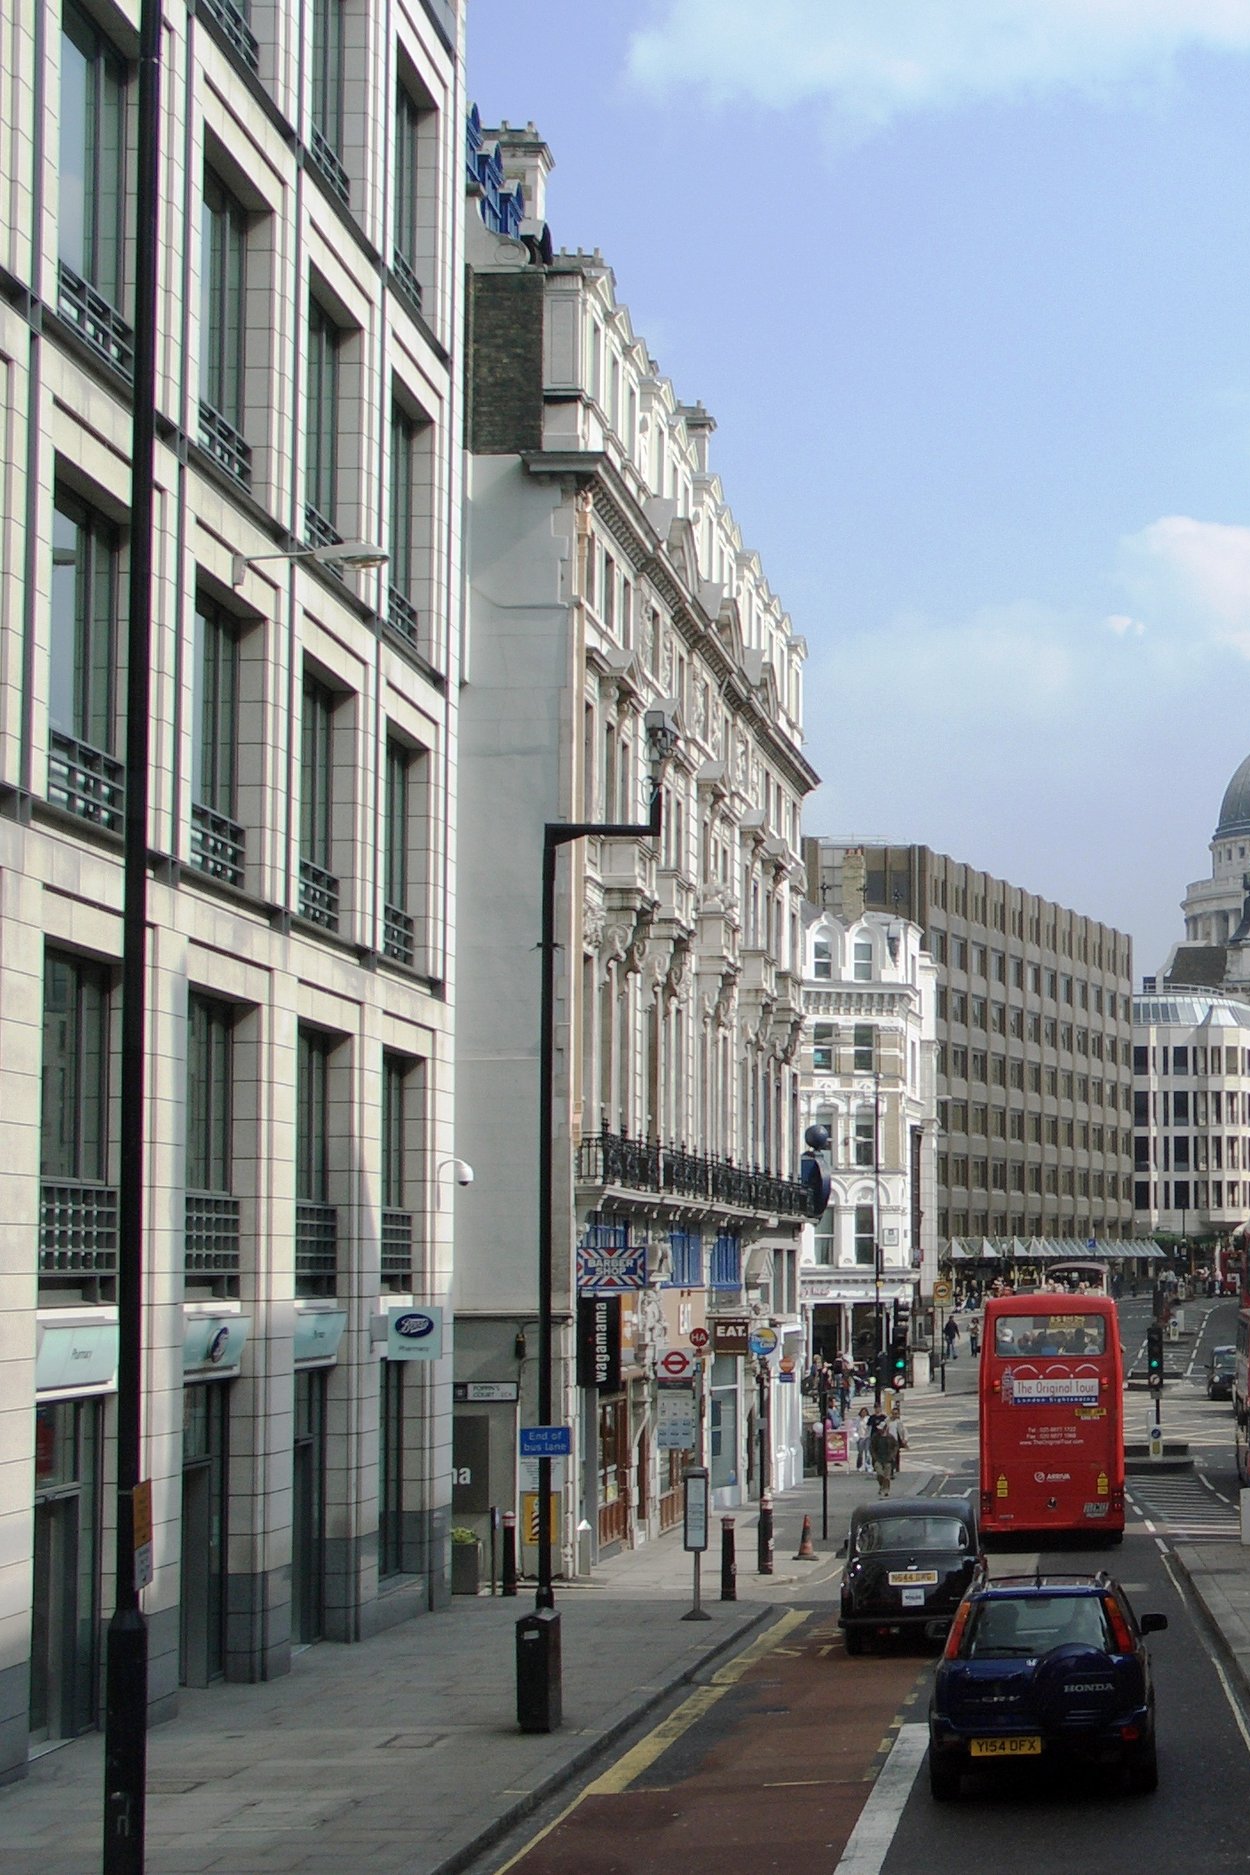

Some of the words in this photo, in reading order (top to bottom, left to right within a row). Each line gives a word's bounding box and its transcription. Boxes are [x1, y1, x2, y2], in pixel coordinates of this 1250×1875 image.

[587, 1259, 634, 1268] BARBER
[595, 1267, 627, 1276] SHOP
[595, 1302, 611, 1382] wagamama
[691, 1333, 707, 1342] HA
[1017, 1381, 1033, 1394] The
[1036, 1380, 1072, 1397] Original
[1075, 1380, 1095, 1393] Tour
[529, 1432, 548, 1440] End
[551, 1431, 562, 1440] of
[524, 1443, 542, 1452] bus
[545, 1442, 567, 1451] lane
[1063, 1683, 1115, 1693] HONDA
[977, 1740, 1007, 1753] Y154
[1010, 1739, 1036, 1752] DFX
